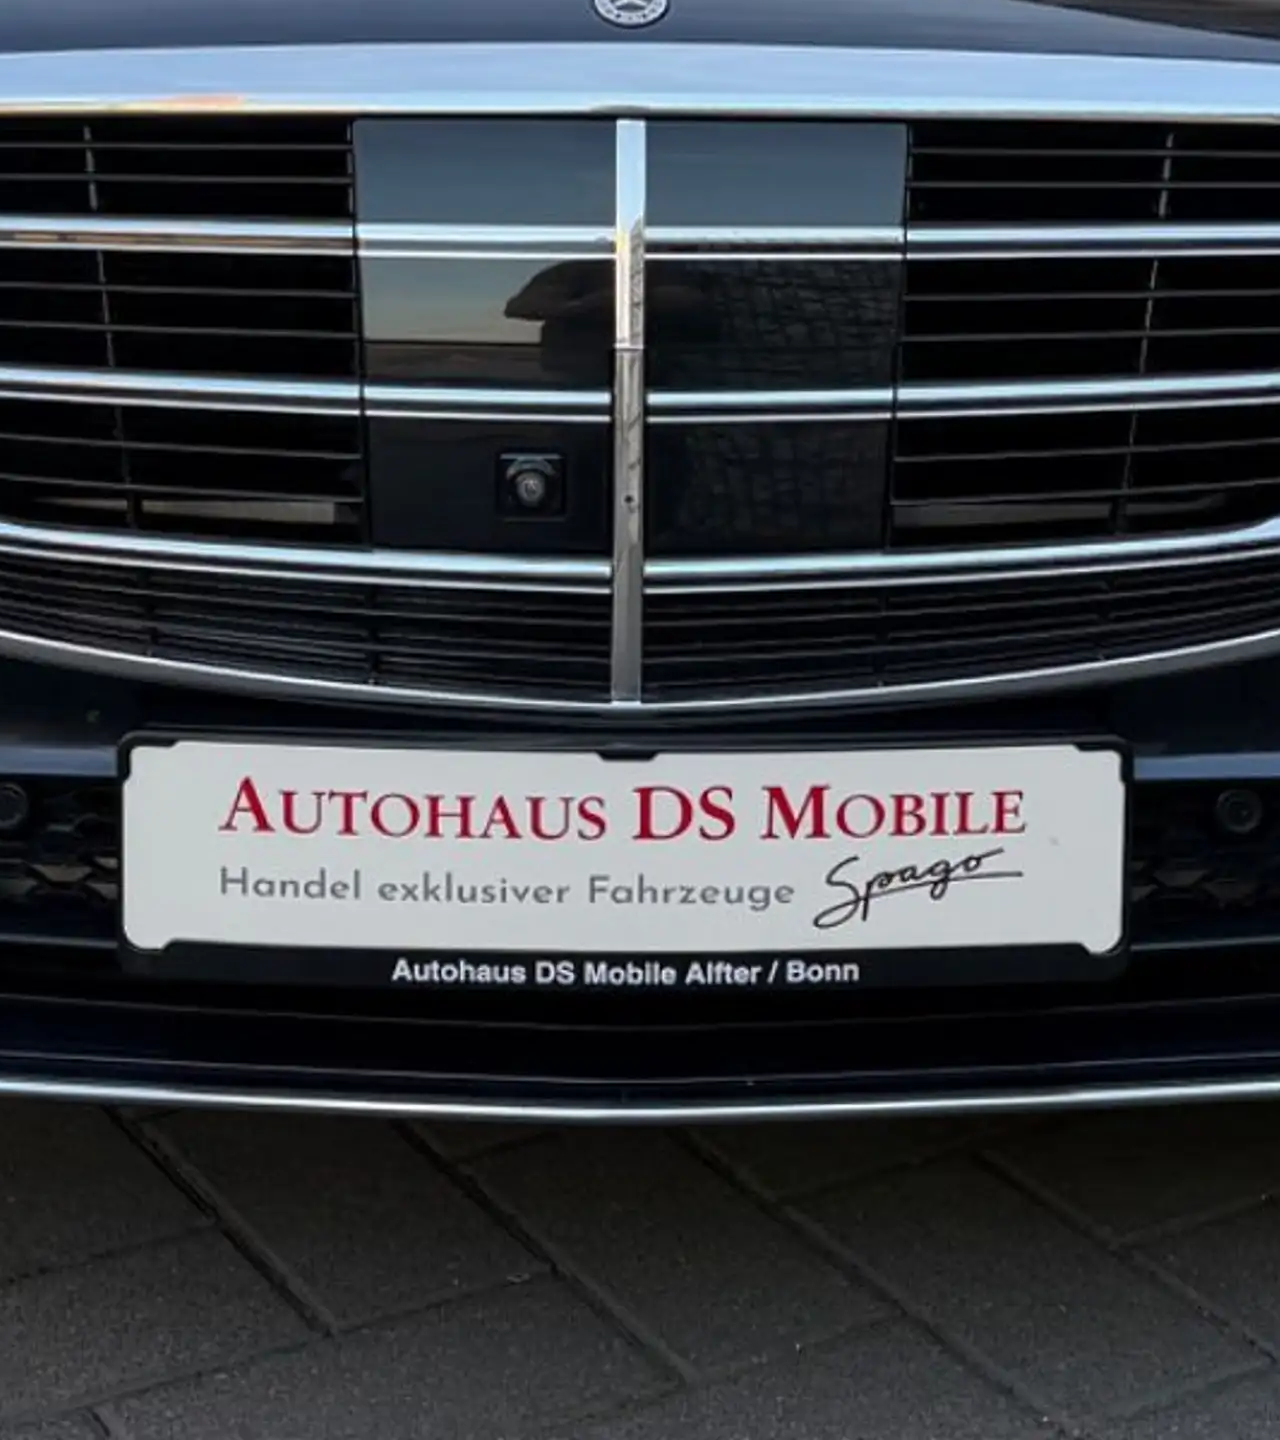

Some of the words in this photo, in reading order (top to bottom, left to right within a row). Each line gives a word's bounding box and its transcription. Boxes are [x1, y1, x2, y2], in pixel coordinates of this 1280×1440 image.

[632, 785, 737, 842] DS
[220, 866, 362, 901] Handel
[377, 871, 572, 905] exklusiver
[588, 872, 796, 912] Fahrzeuge
[392, 957, 528, 984] Autohaus
[535, 959, 576, 985] DS
[584, 960, 677, 986] Mobile
[685, 960, 763, 985] Alfter
[767, 960, 780, 984] /
[786, 959, 860, 984] Bonn
